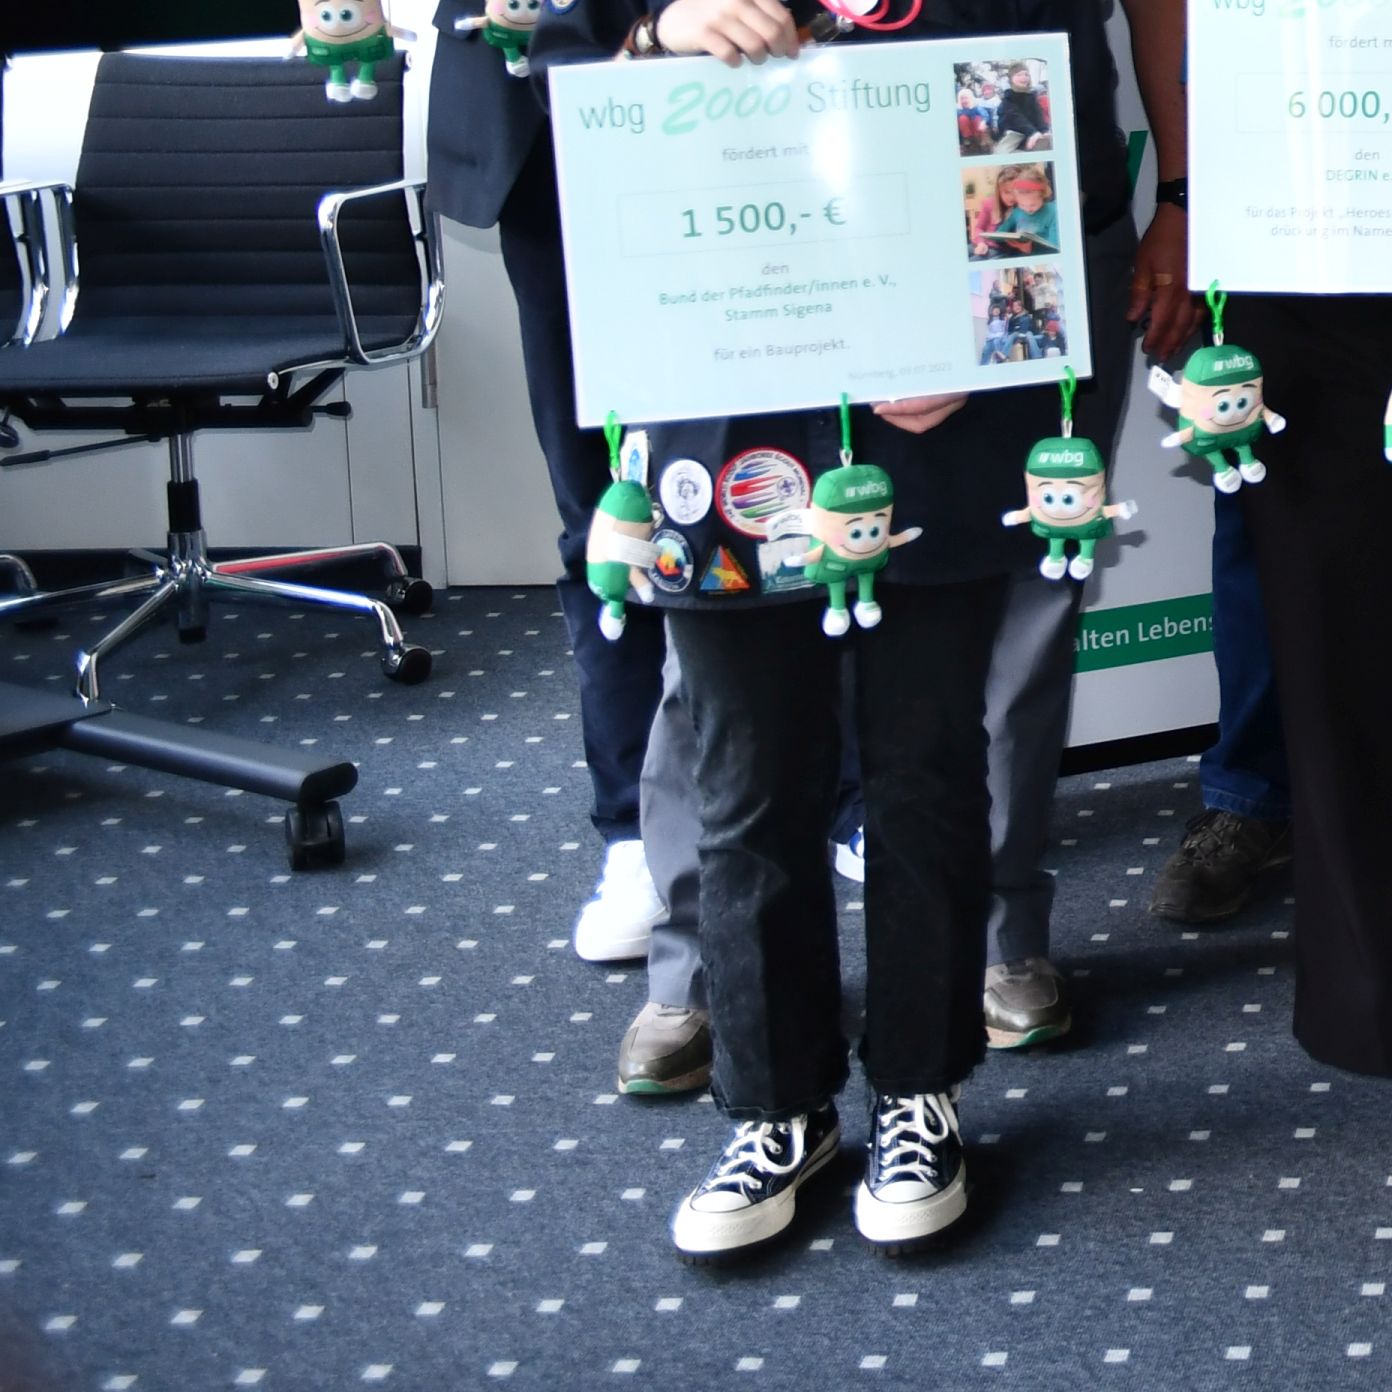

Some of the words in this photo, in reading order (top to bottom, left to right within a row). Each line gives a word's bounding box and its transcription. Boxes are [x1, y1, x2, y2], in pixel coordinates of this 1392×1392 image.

[579, 97, 646, 134] wbg
[662, 81, 792, 135] 2000
[806, 81, 930, 113] Stiftung
[1289, 91, 1306, 118] 6
[722, 146, 777, 161] fördert
[683, 209, 702, 237] 1
[716, 202, 811, 235] 500,-
[822, 198, 846, 225] €
[761, 263, 789, 275] den
[659, 291, 696, 305] Bund
[701, 290, 725, 302] der
[725, 308, 778, 321] Stamm
[783, 303, 832, 319] Sigena
[713, 348, 735, 360] für
[739, 349, 761, 359] ein
[766, 339, 849, 357] Bauprojekt.
